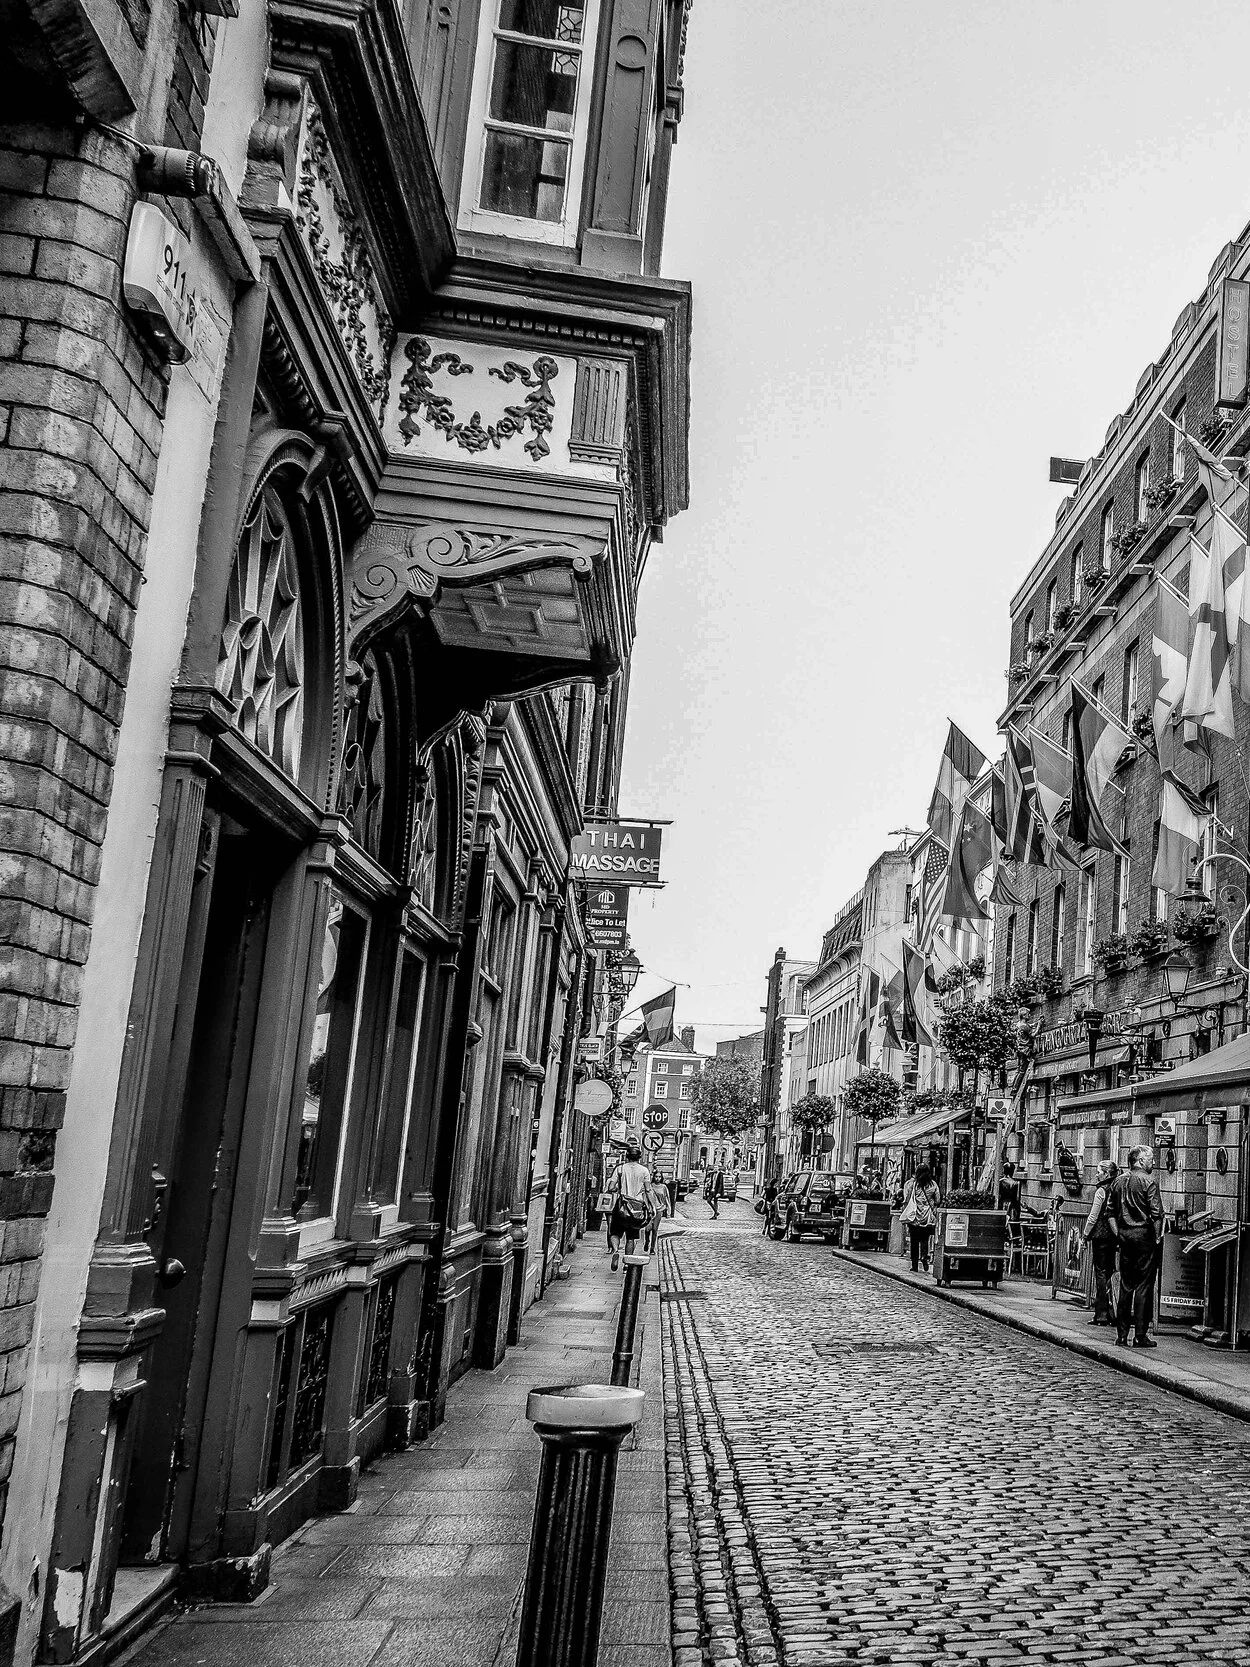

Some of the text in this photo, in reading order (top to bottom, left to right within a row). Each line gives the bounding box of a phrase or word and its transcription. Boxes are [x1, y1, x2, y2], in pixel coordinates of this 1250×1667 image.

[586, 830, 646, 850] THAI
[571, 853, 660, 874] MASSAGE
[605, 918, 614, 926] To
[615, 919, 627, 927] Let
[643, 1111, 668, 1122] STOP
[1171, 1297, 1192, 1305] FRIDAY
